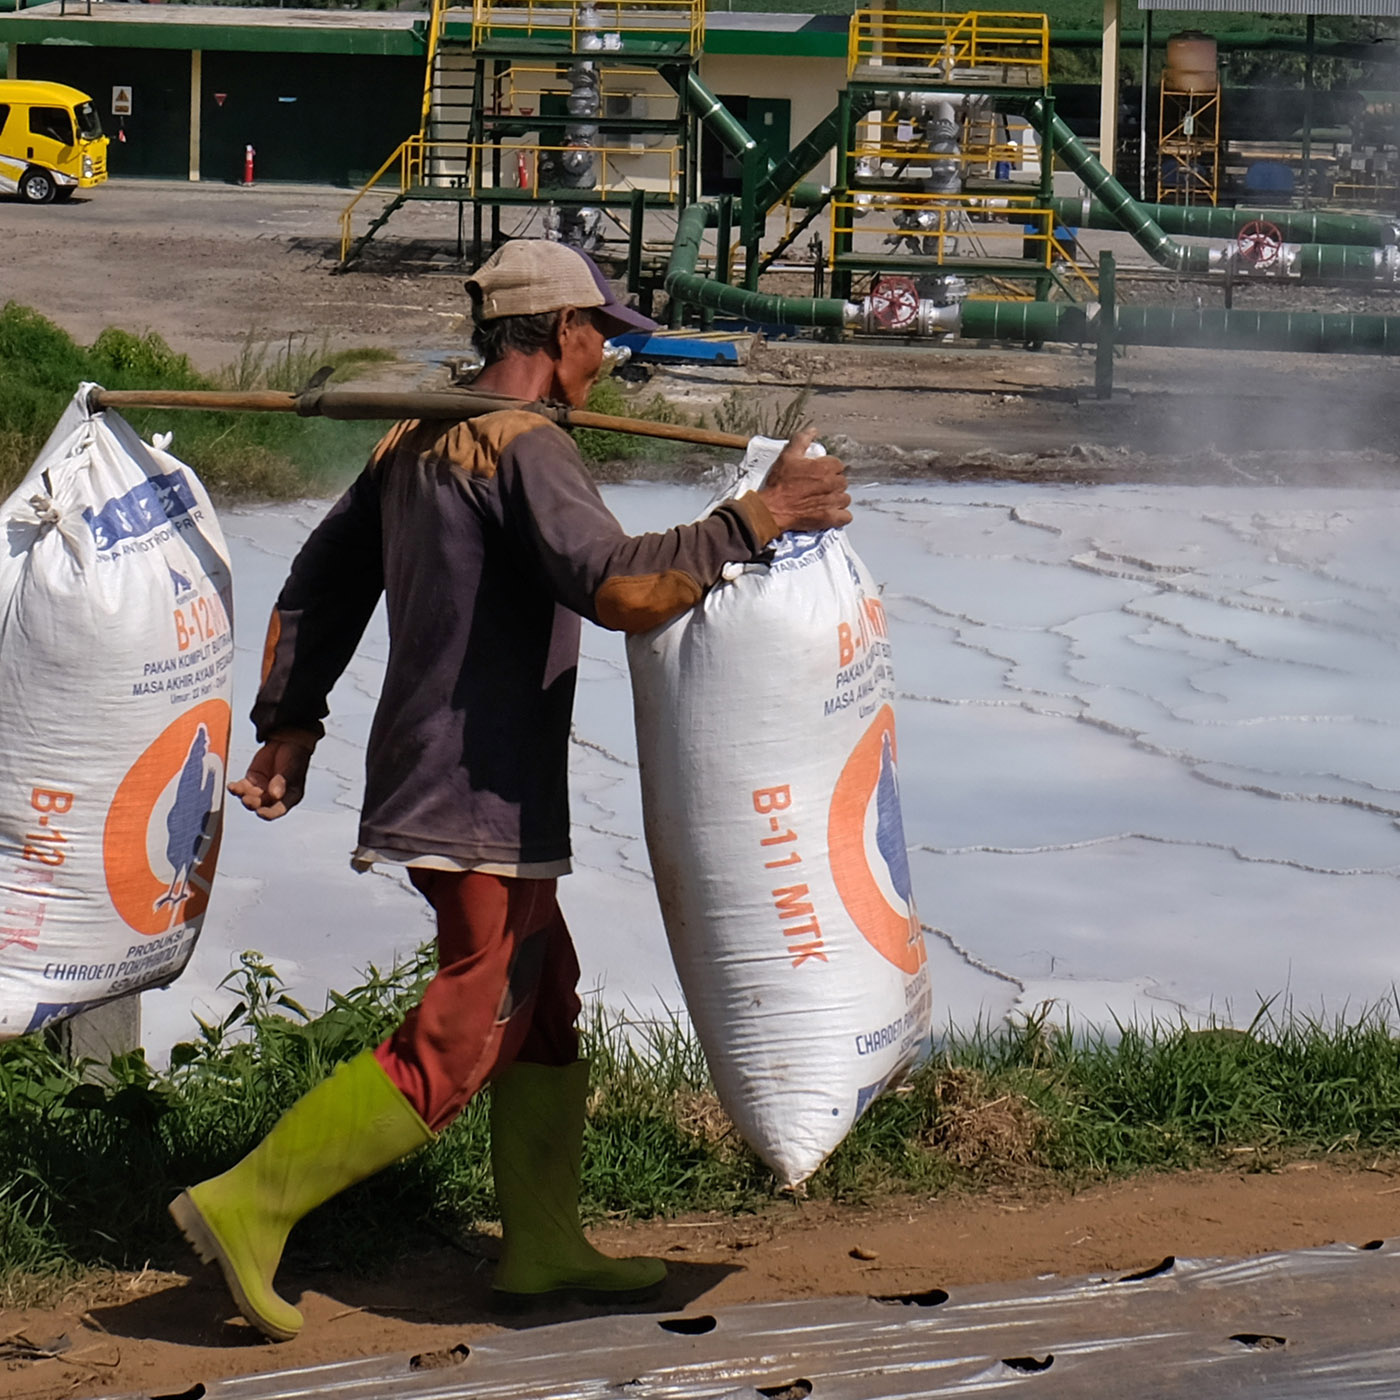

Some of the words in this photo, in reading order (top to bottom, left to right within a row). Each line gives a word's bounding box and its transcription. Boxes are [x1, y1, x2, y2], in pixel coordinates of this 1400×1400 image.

[143, 660, 178, 676] PAKAN
[132, 680, 164, 697] MASA
[823, 689, 854, 716] MASA
[22, 787, 75, 867] B-12
[771, 883, 829, 969] MTK
[126, 930, 185, 958] PRODUKSI
[43, 962, 115, 981] CHAROEN
